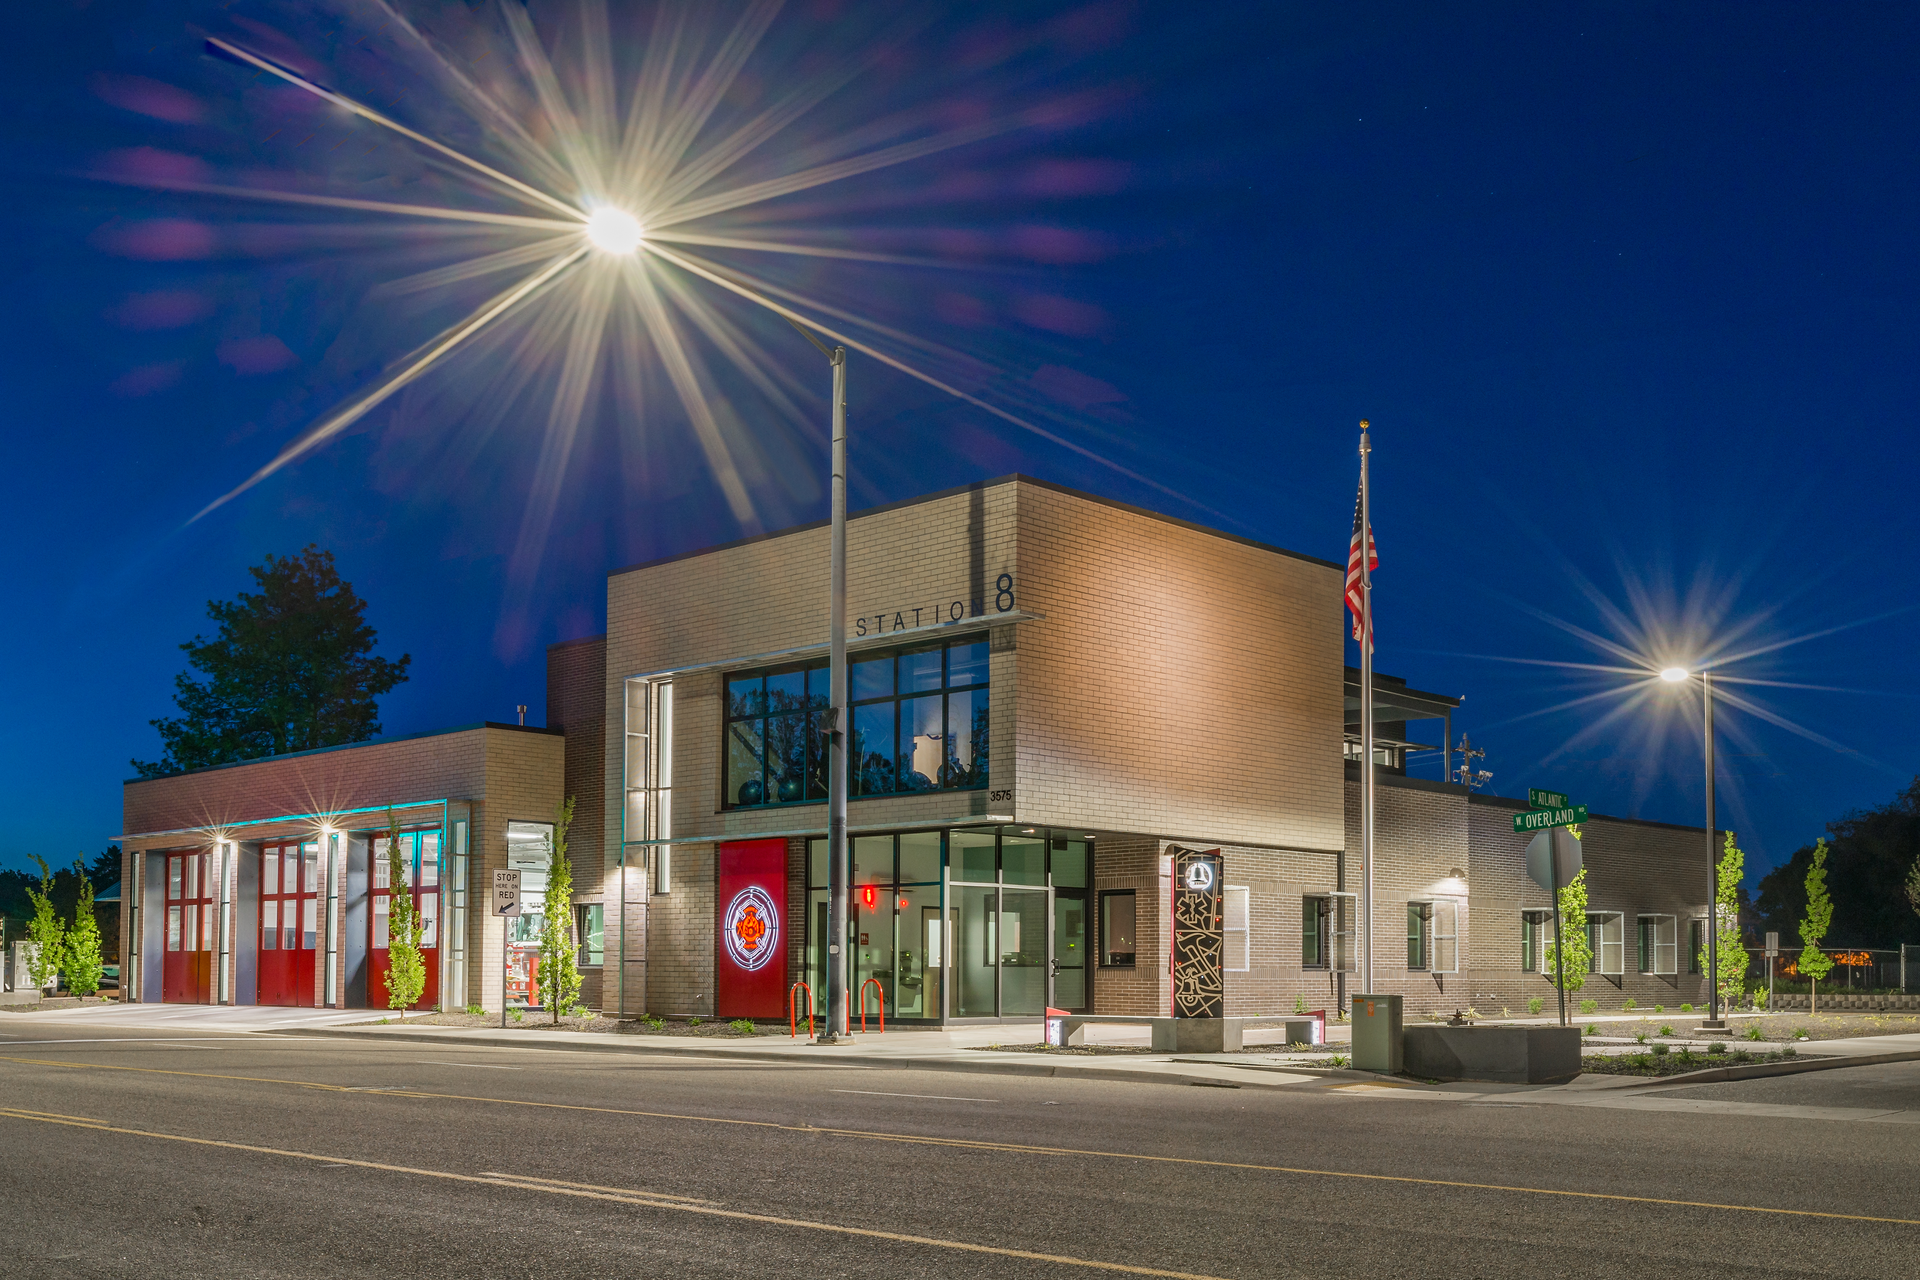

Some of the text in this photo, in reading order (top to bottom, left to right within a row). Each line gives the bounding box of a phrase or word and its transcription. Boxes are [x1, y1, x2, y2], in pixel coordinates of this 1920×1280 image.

[856, 573, 1015, 637] STATION 8
[990, 790, 1012, 802] 3575
[1538, 791, 1563, 808] ATLANTIC
[1525, 809, 1574, 828] OVERLAND
[496, 873, 517, 882] STOP
[499, 891, 515, 899] RED
